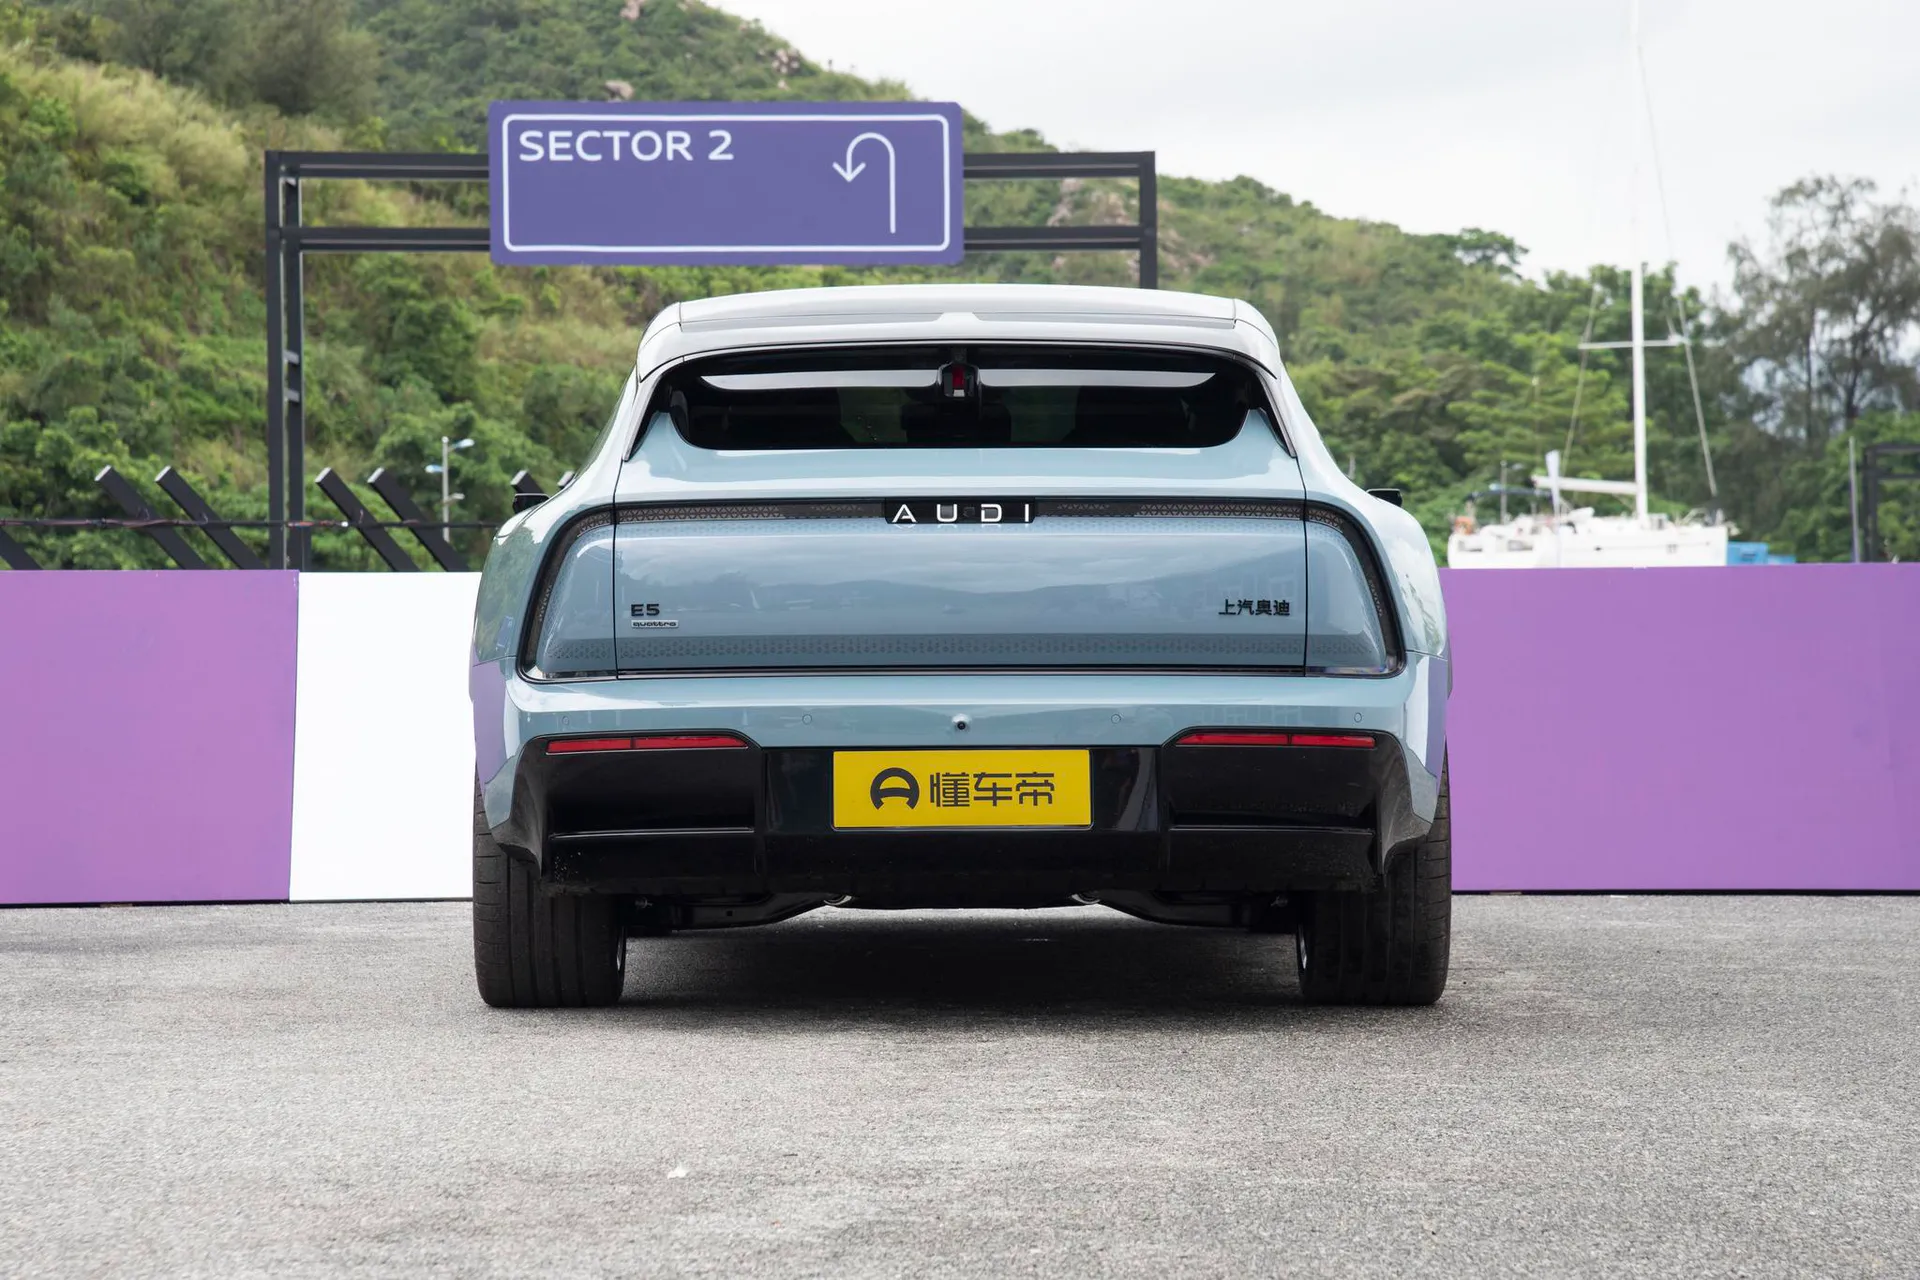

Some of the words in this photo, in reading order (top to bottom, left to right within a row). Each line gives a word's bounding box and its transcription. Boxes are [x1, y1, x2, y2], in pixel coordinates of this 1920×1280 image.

[519, 130, 693, 161] SECTOR
[708, 129, 734, 161] 2
[892, 503, 1030, 523] AUDI
[631, 603, 660, 617] E5
[1218, 599, 1290, 616] 上汽奥迪
[929, 771, 1055, 808] 懂车帝
